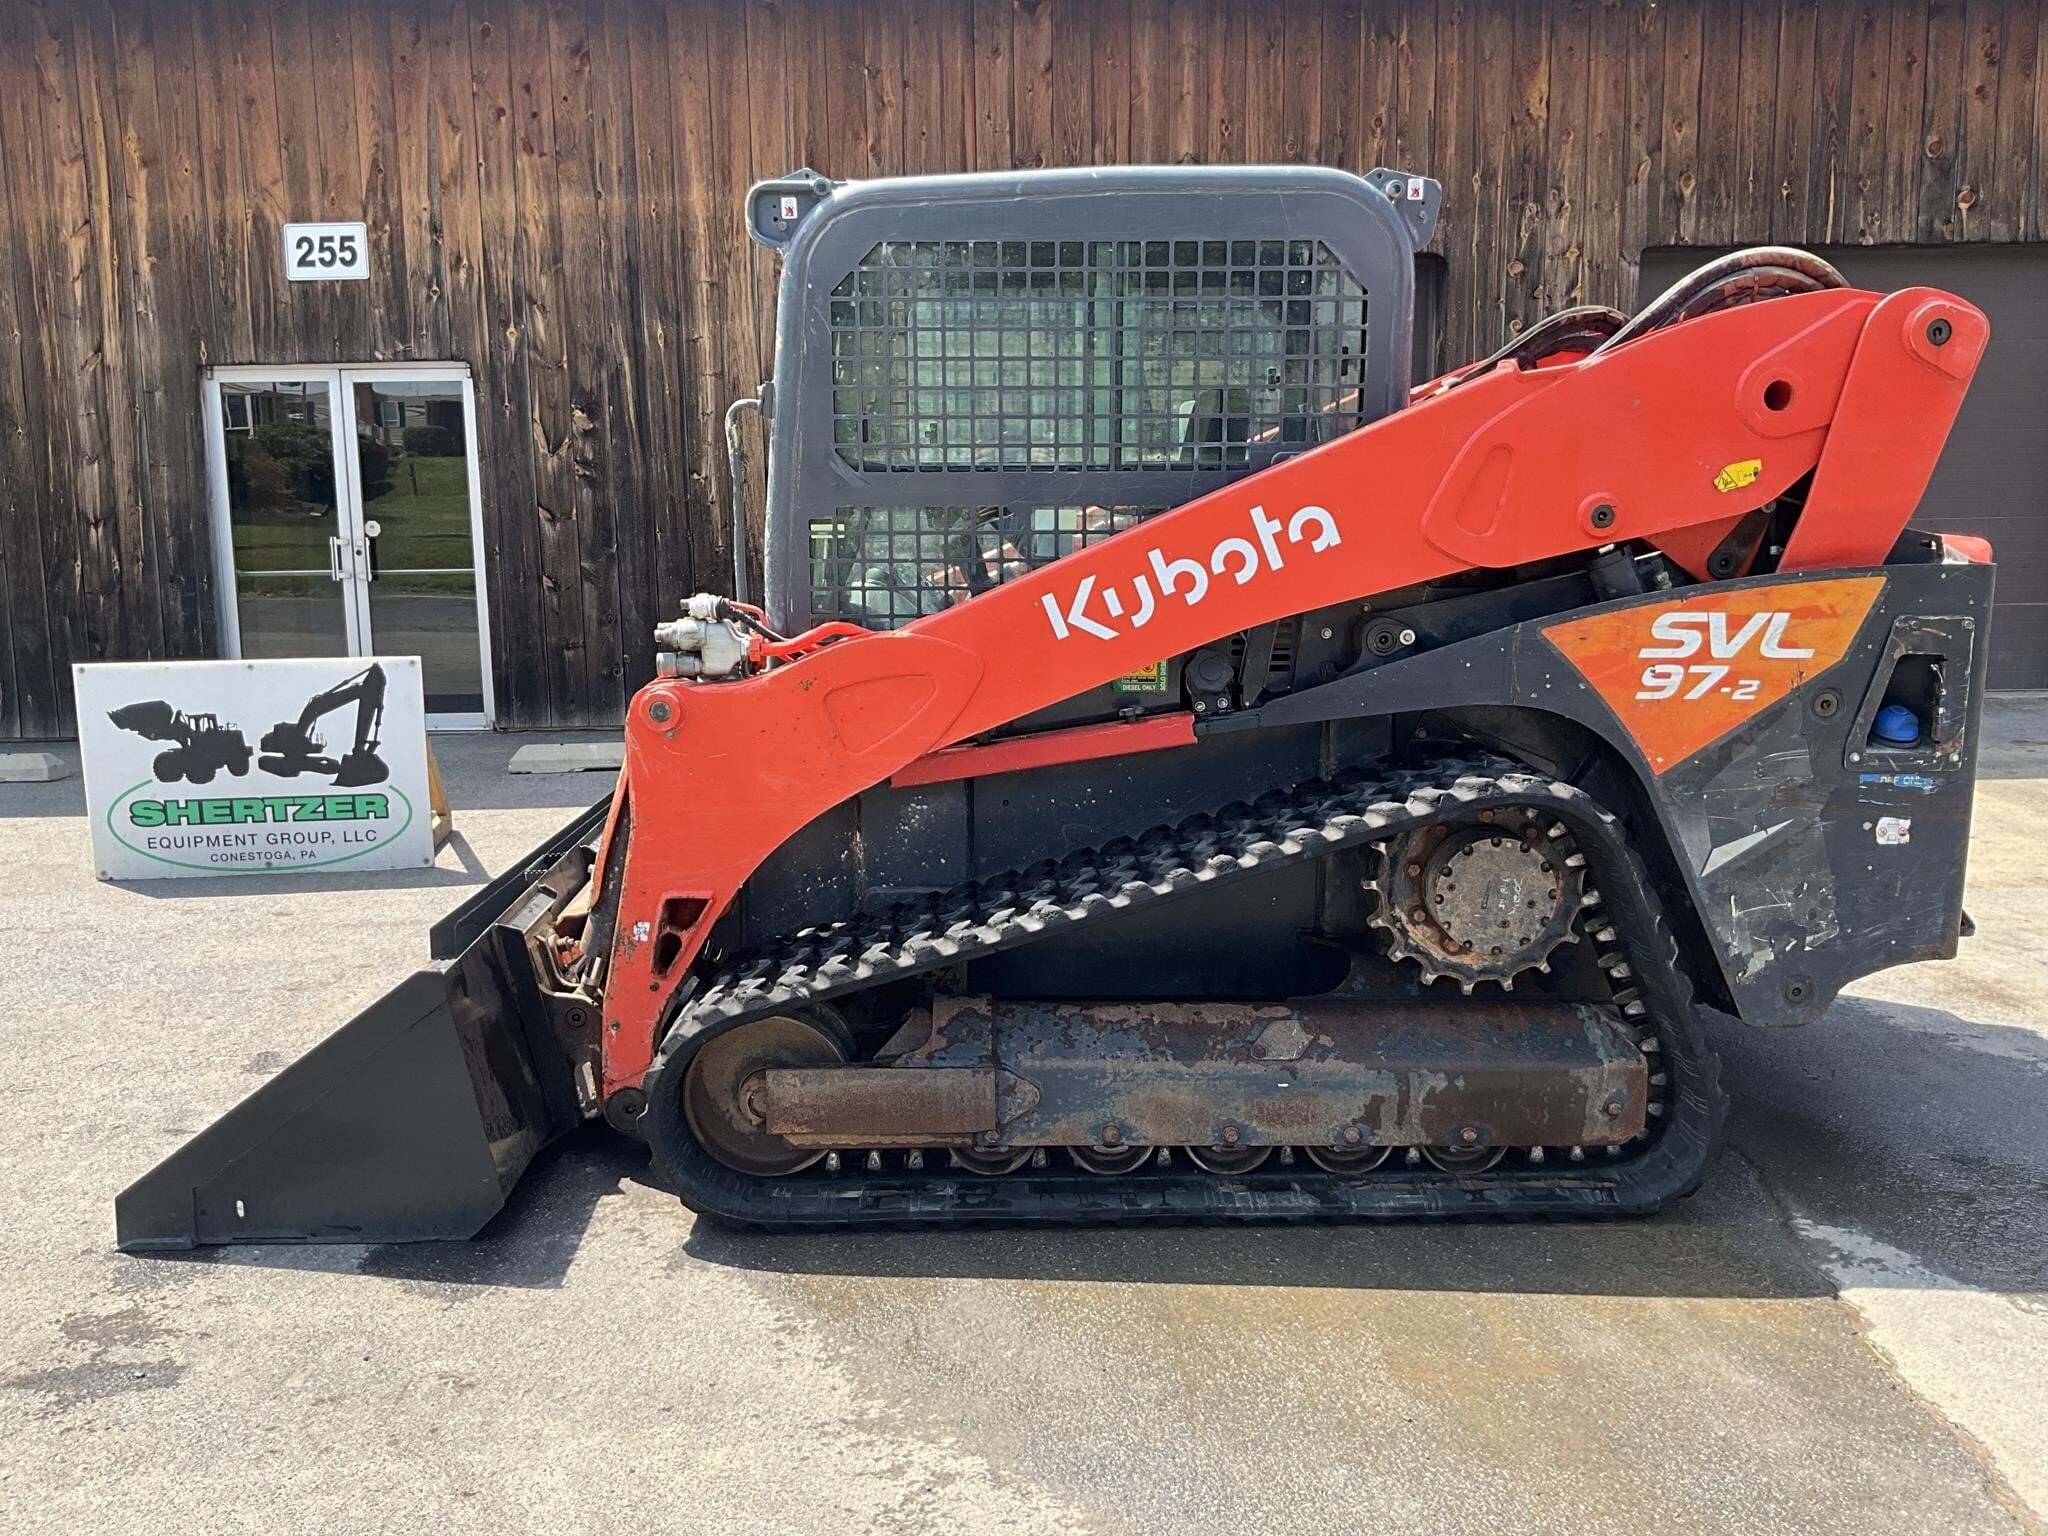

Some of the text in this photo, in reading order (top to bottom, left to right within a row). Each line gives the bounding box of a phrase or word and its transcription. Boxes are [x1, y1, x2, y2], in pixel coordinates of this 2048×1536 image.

[296, 235, 358, 268] 255
[1040, 505, 1342, 640] Kubota
[1638, 611, 1814, 659] SVL
[1635, 665, 1760, 700] 97-2
[129, 793, 389, 827] SHERTZER
[147, 829, 377, 850] EQUIPMENT GROUP, LLC
[210, 850, 317, 864] CONESTOGA, PA
